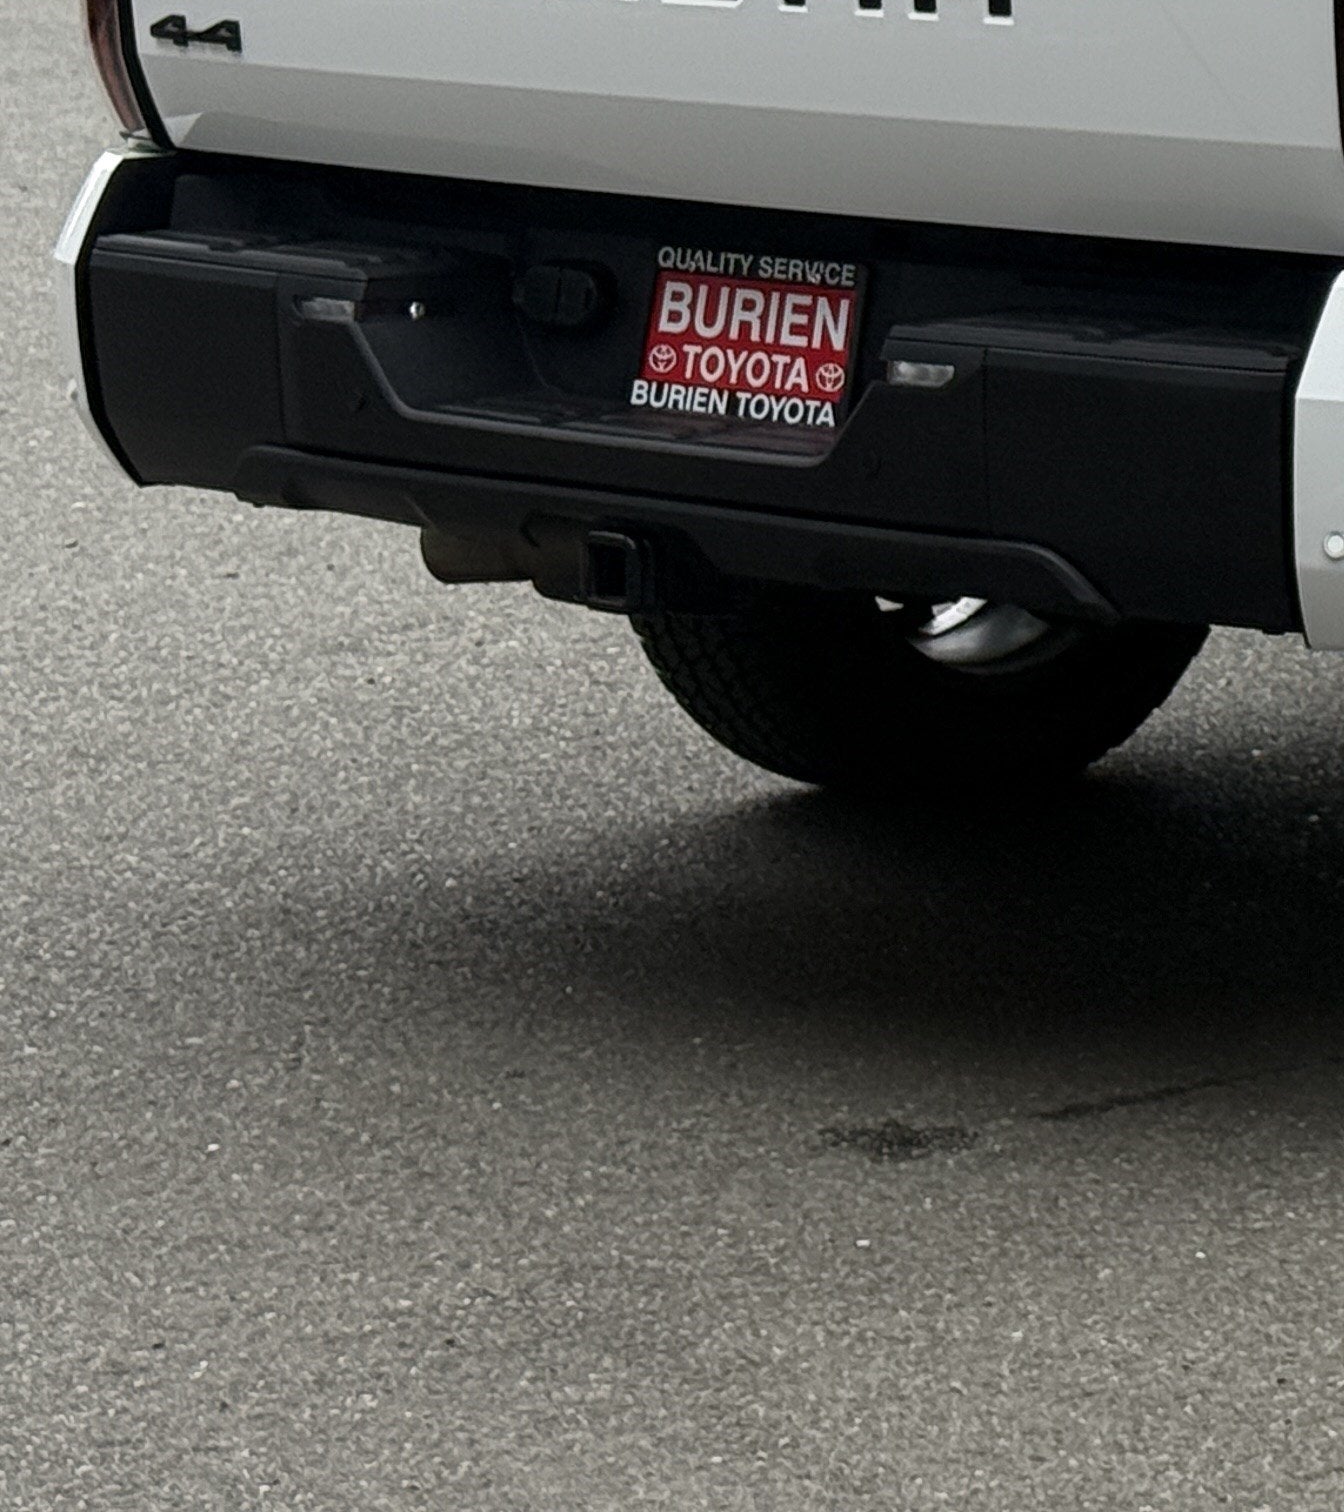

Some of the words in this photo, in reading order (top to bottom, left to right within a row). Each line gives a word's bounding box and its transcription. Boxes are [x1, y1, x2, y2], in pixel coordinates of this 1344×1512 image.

[657, 245, 754, 277] QUALITY
[758, 256, 856, 287] SERVICE
[657, 280, 850, 352] BURIEN
[682, 344, 810, 393] TOYOTA
[629, 379, 729, 416] BURIEN
[736, 391, 836, 428] TOYOTA
